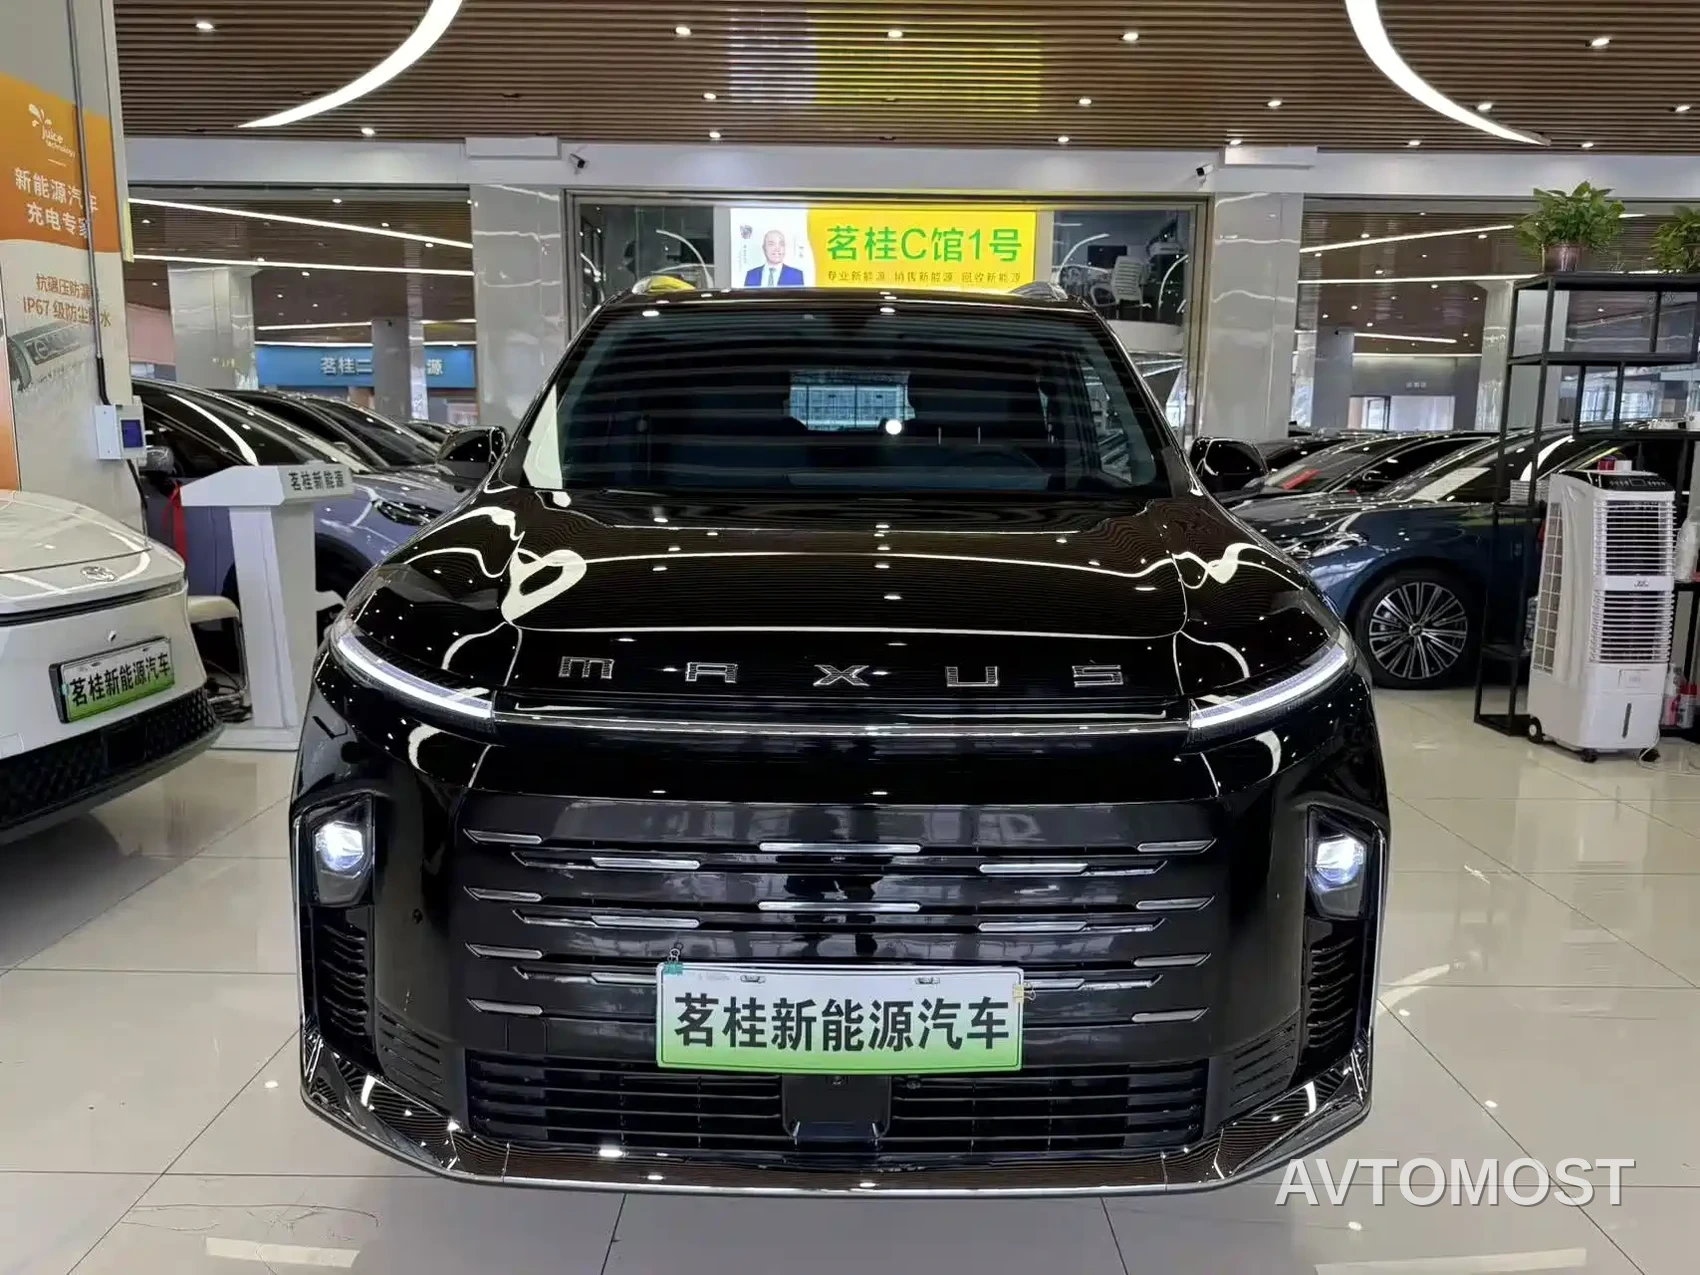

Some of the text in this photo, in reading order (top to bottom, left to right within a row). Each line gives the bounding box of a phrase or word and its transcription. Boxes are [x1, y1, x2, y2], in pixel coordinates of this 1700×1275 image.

[827, 225, 1022, 262] 茗桂C馆1号
[23, 296, 50, 316] IP67
[69, 652, 171, 707] 茗桂新能源汽车
[558, 655, 1124, 689] MAXUS
[674, 992, 1009, 1052] 茗桂新能源汽车
